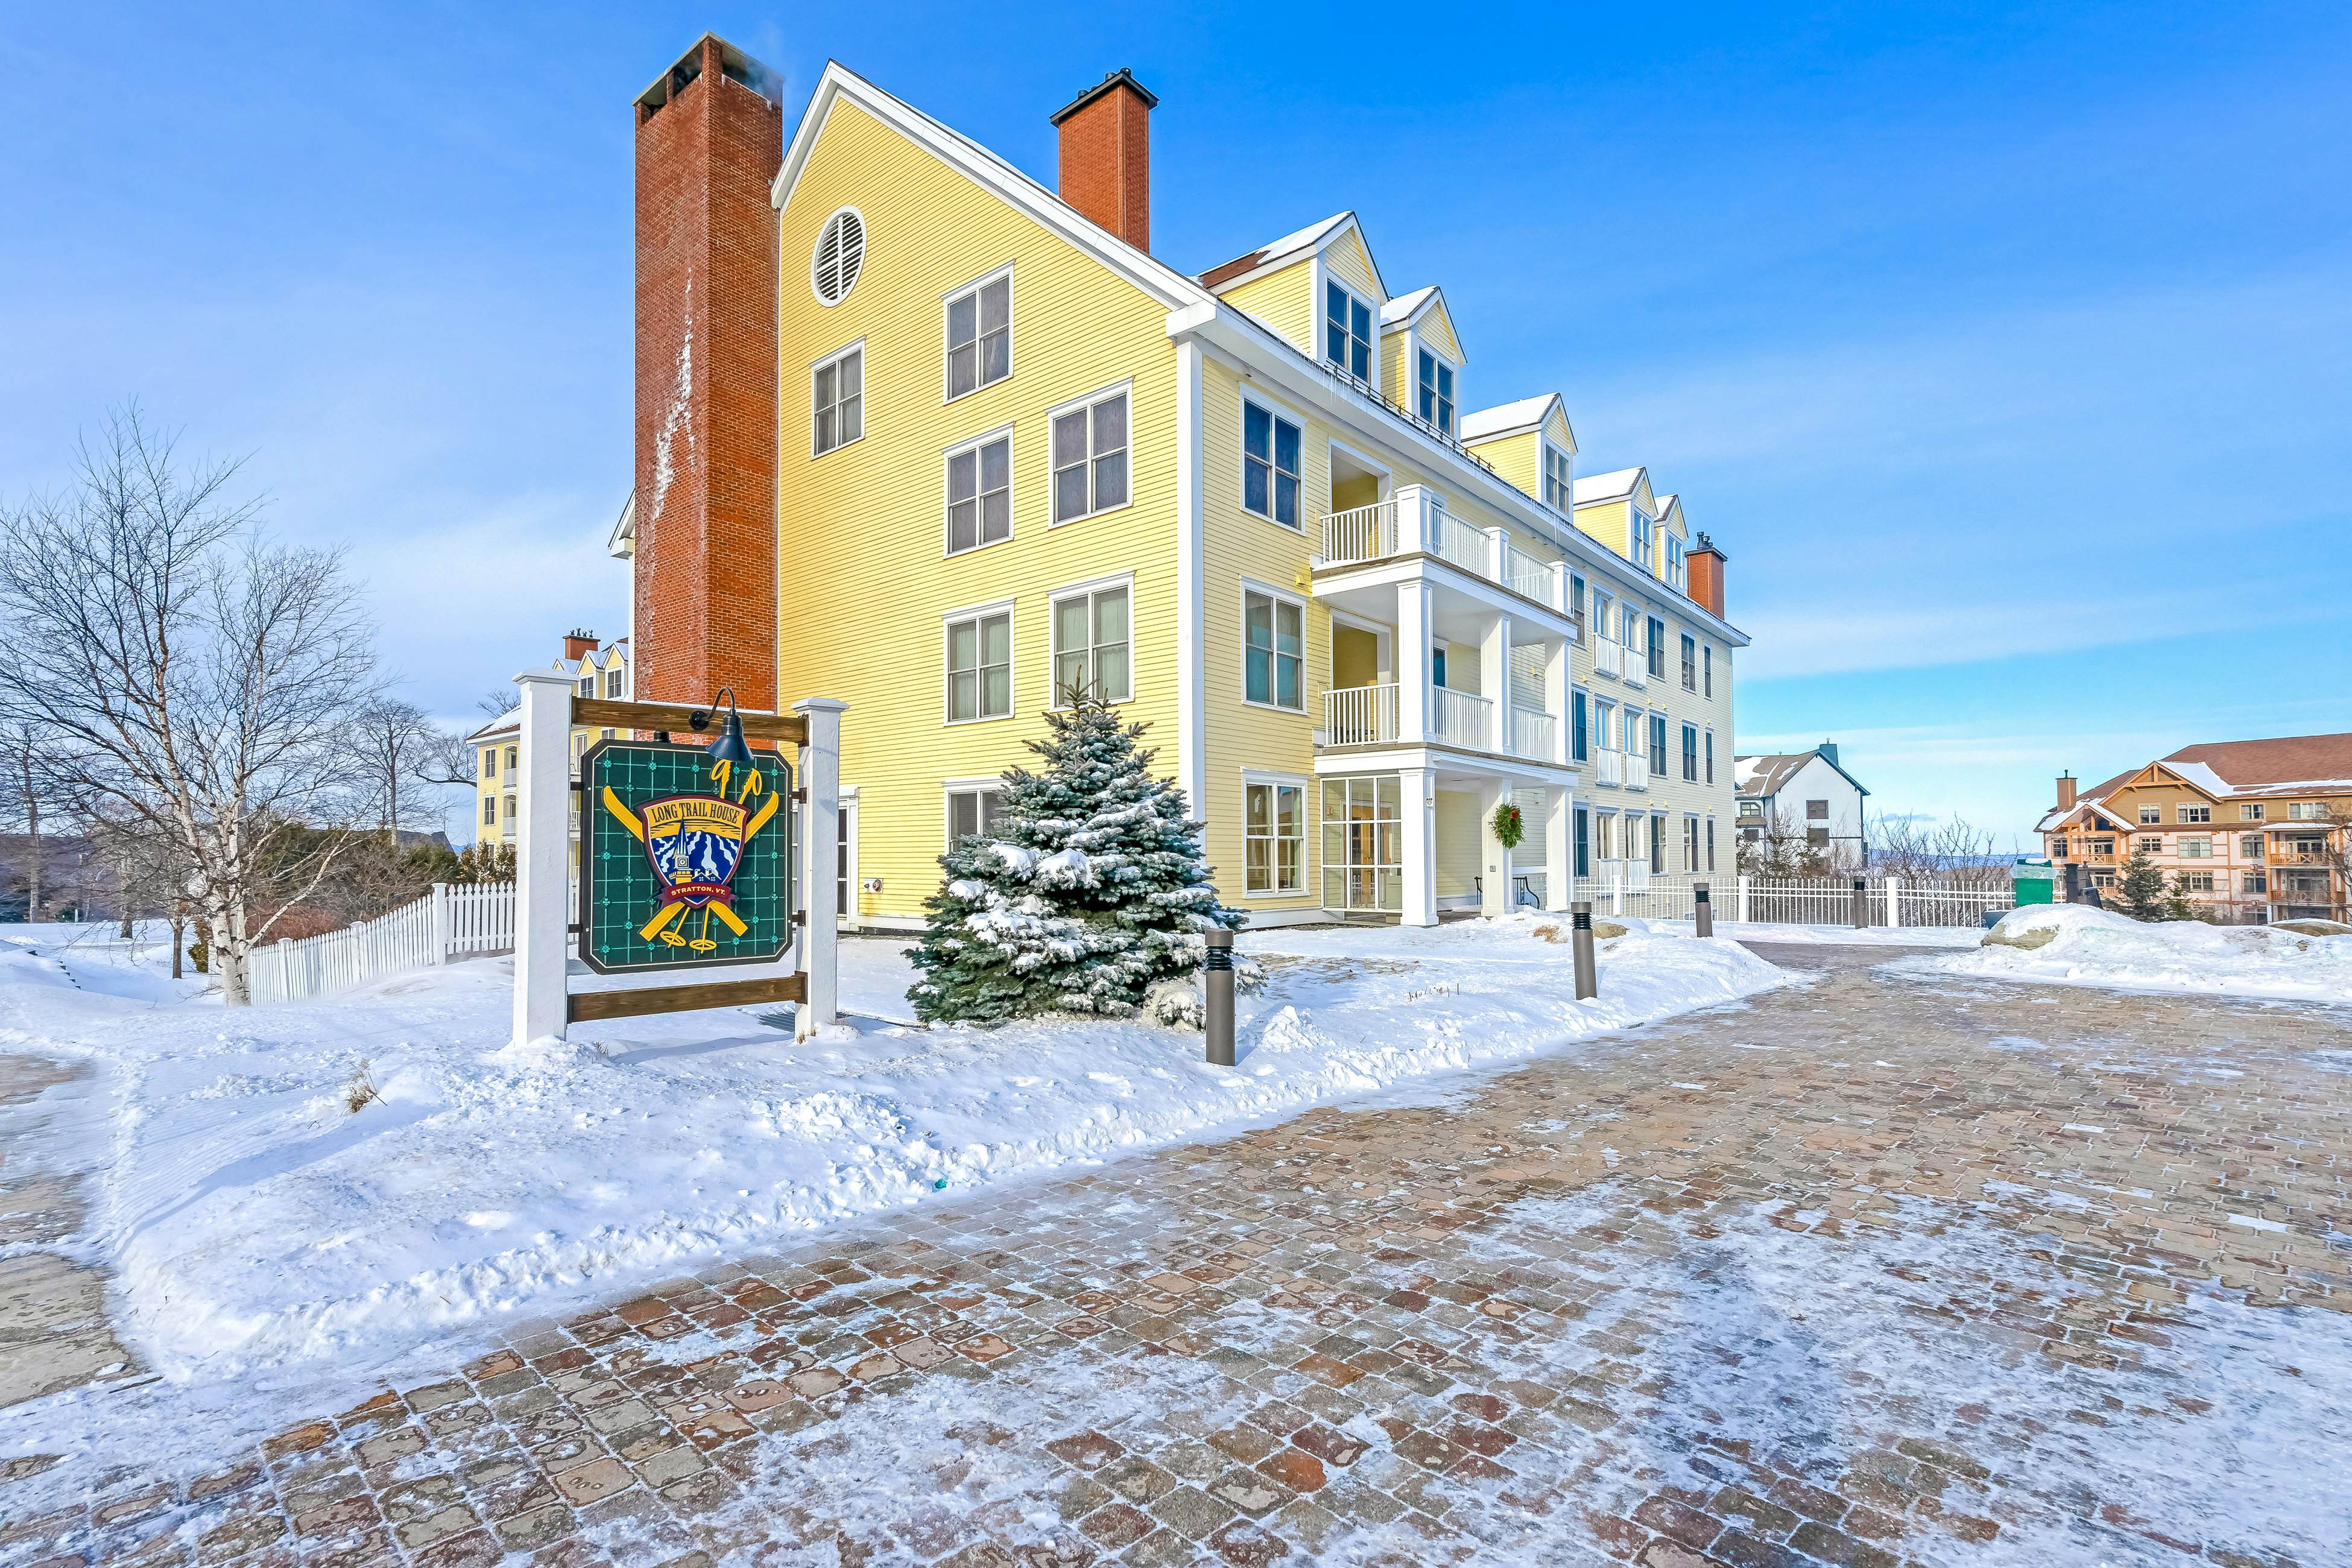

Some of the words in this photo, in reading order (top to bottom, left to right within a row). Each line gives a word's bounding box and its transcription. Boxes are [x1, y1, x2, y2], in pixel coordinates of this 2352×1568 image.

[651, 803, 677, 823] LONG
[679, 802, 707, 818] TRAIL
[709, 803, 740, 824] HOUSE
[671, 886, 714, 896] STRATTON,
